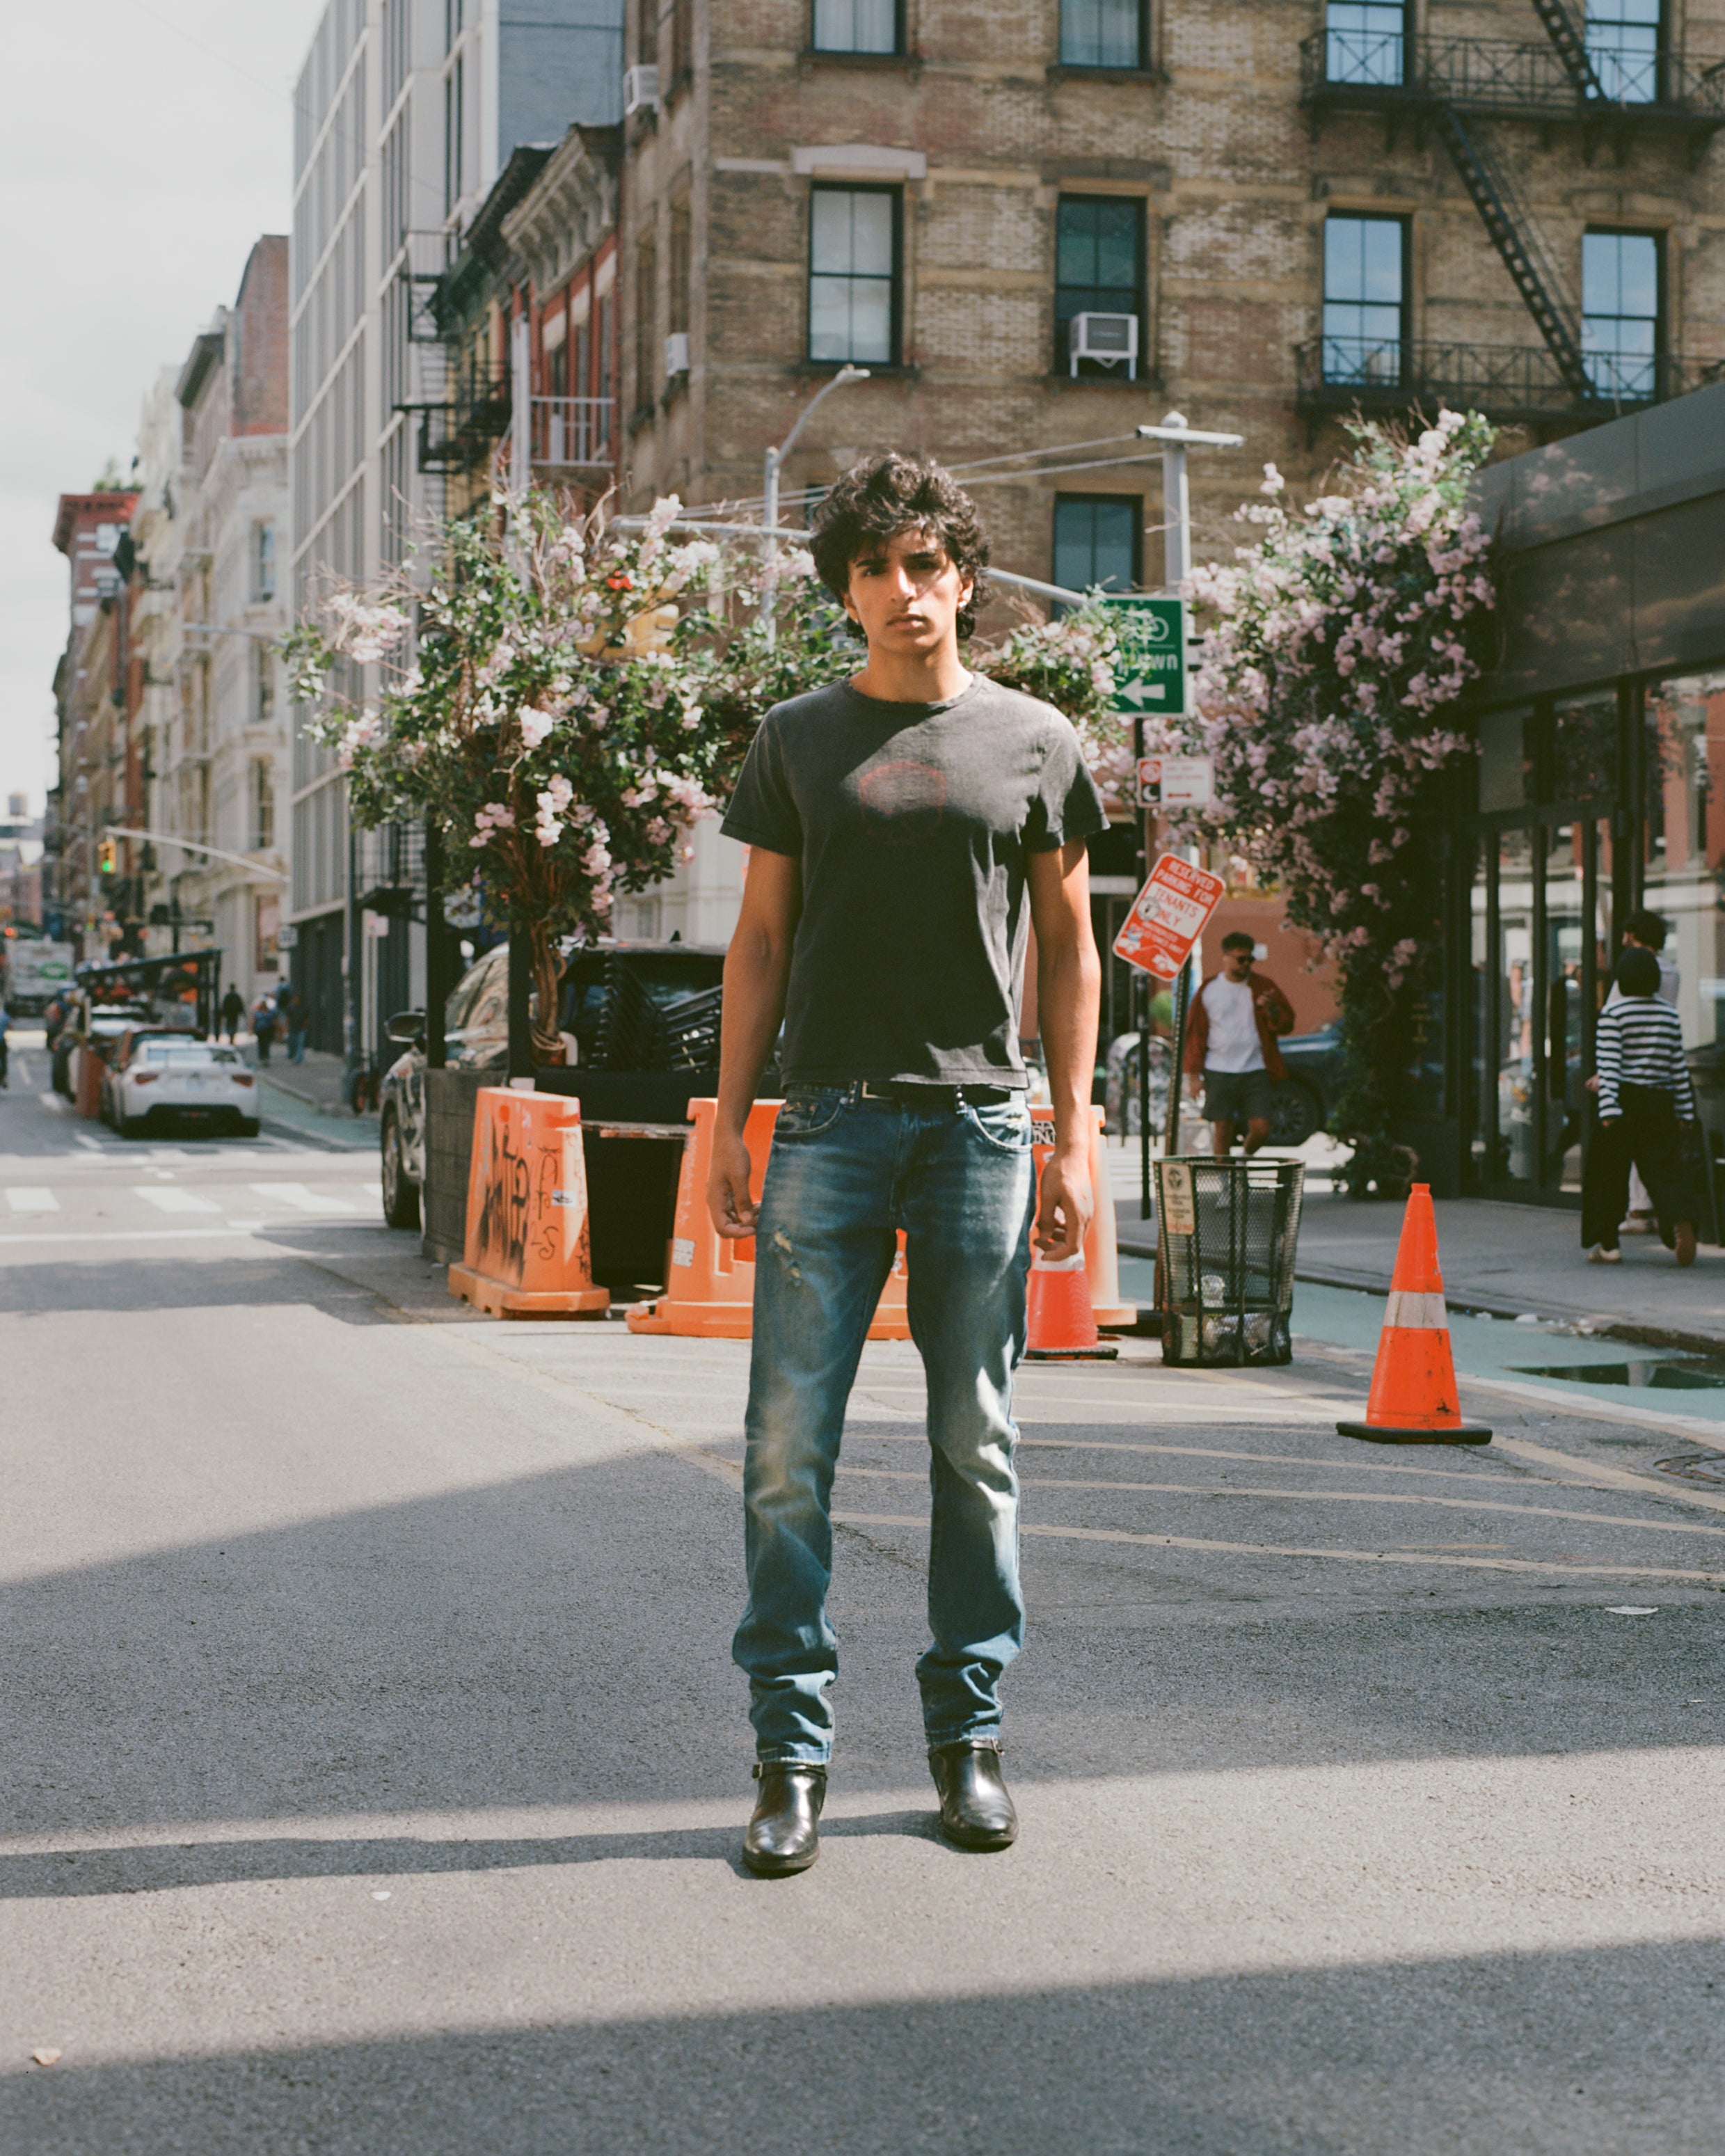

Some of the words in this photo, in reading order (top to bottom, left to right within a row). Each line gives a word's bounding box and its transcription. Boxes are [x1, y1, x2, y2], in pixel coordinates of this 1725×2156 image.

[1155, 869, 1193, 894] PARKING
[1193, 889, 1215, 906] FOR
[1168, 860, 1215, 891] RESERVED
[1155, 887, 1198, 918] TENANTS
[1156, 905, 1182, 926] NLY
